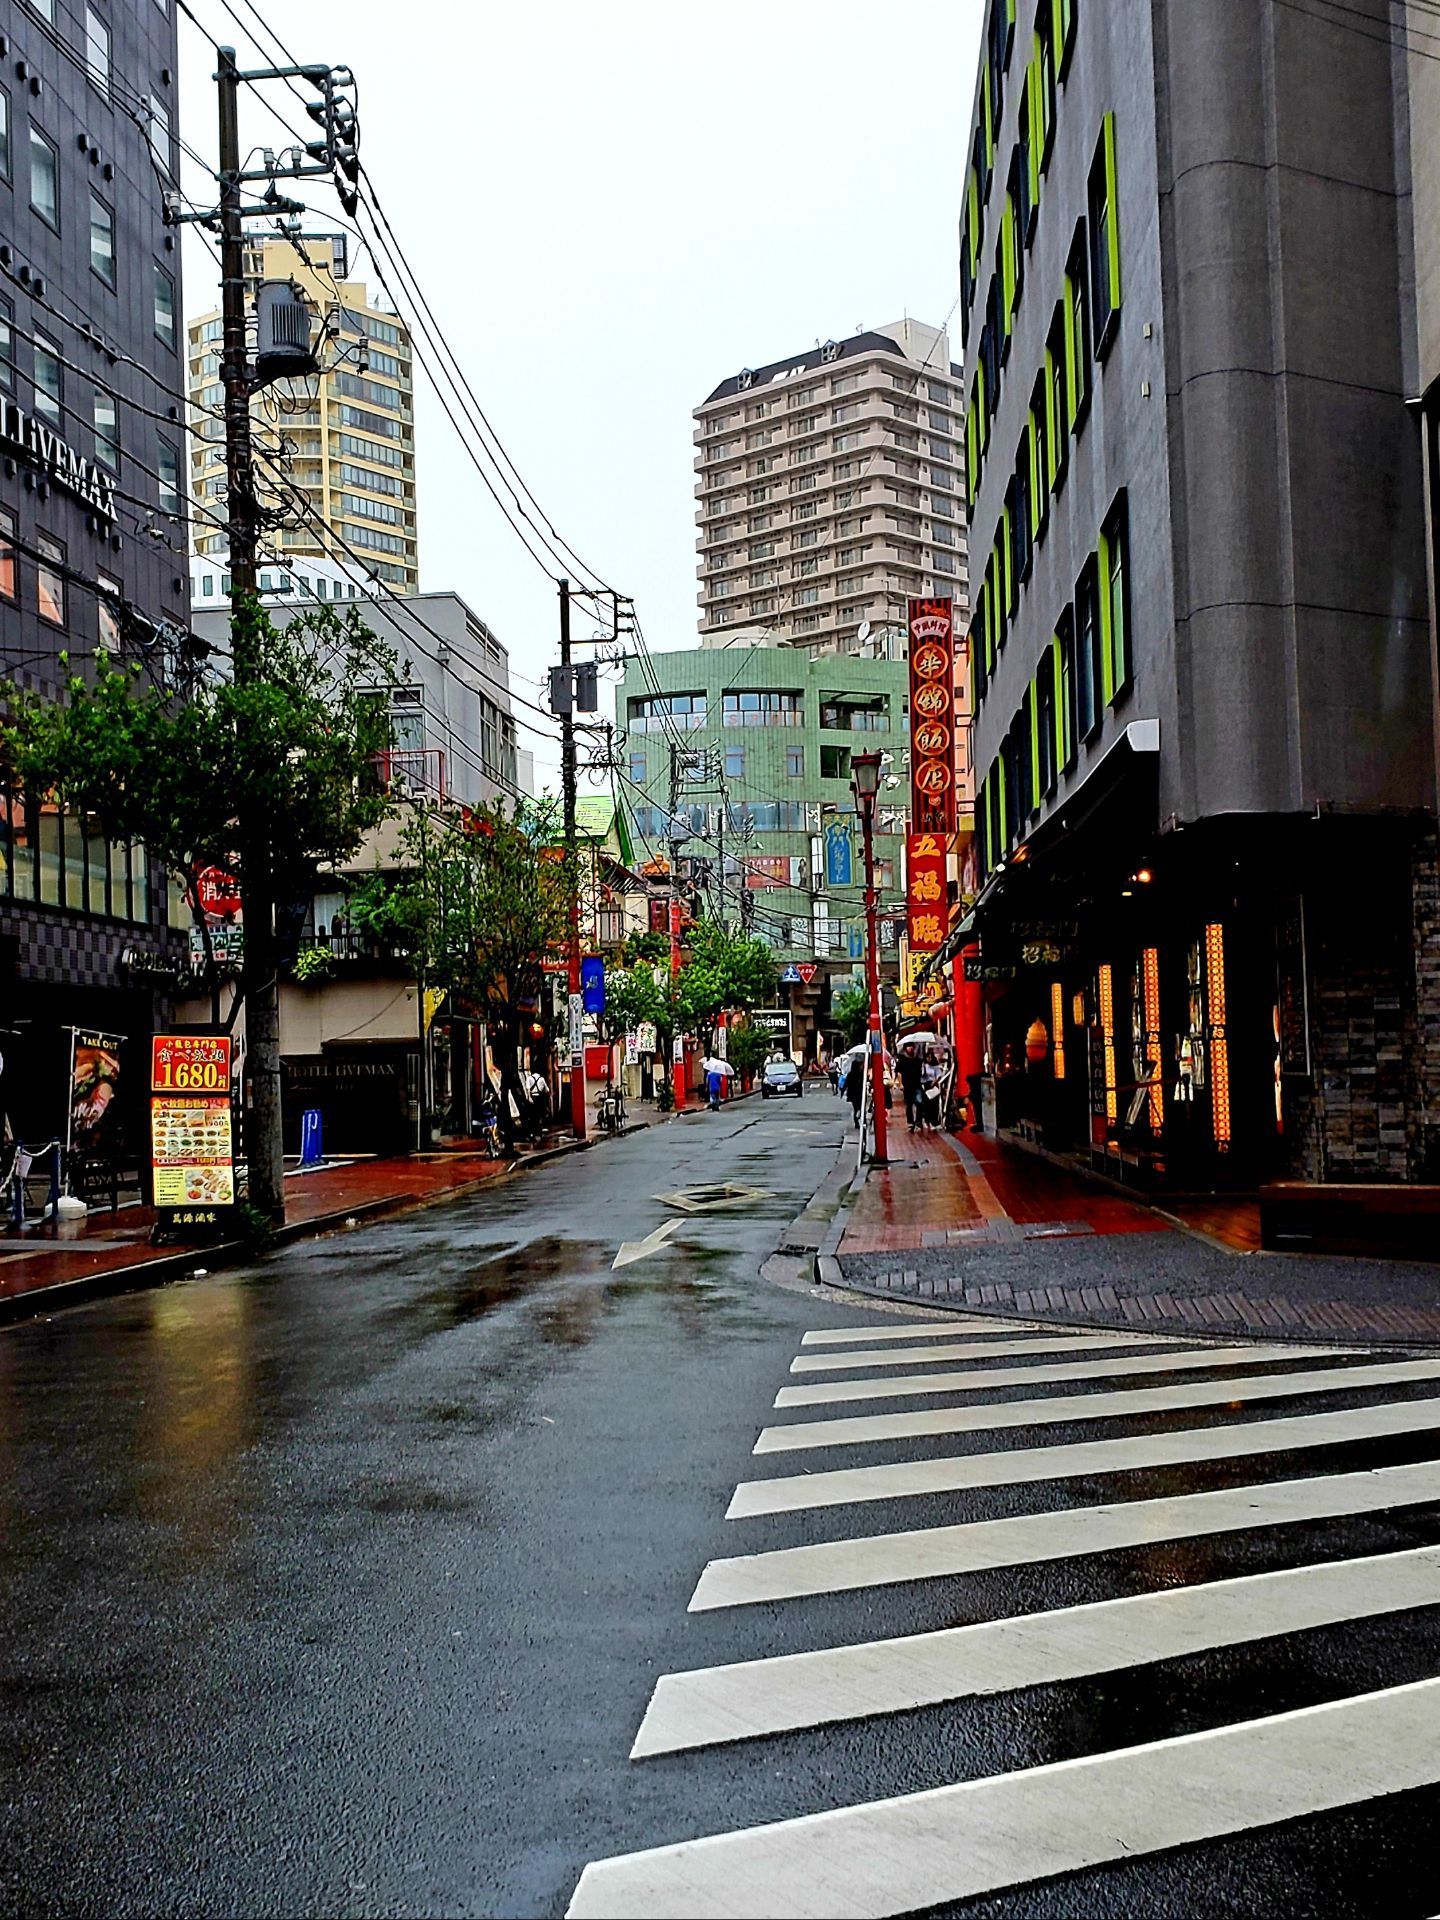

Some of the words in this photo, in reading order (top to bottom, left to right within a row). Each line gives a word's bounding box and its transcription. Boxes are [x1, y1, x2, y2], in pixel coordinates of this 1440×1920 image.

[910, 834, 944, 944] 五福臨
[82, 1035, 101, 1048] TAKE
[102, 1039, 119, 1051] OUT
[156, 1047, 226, 1064] 食べ放題
